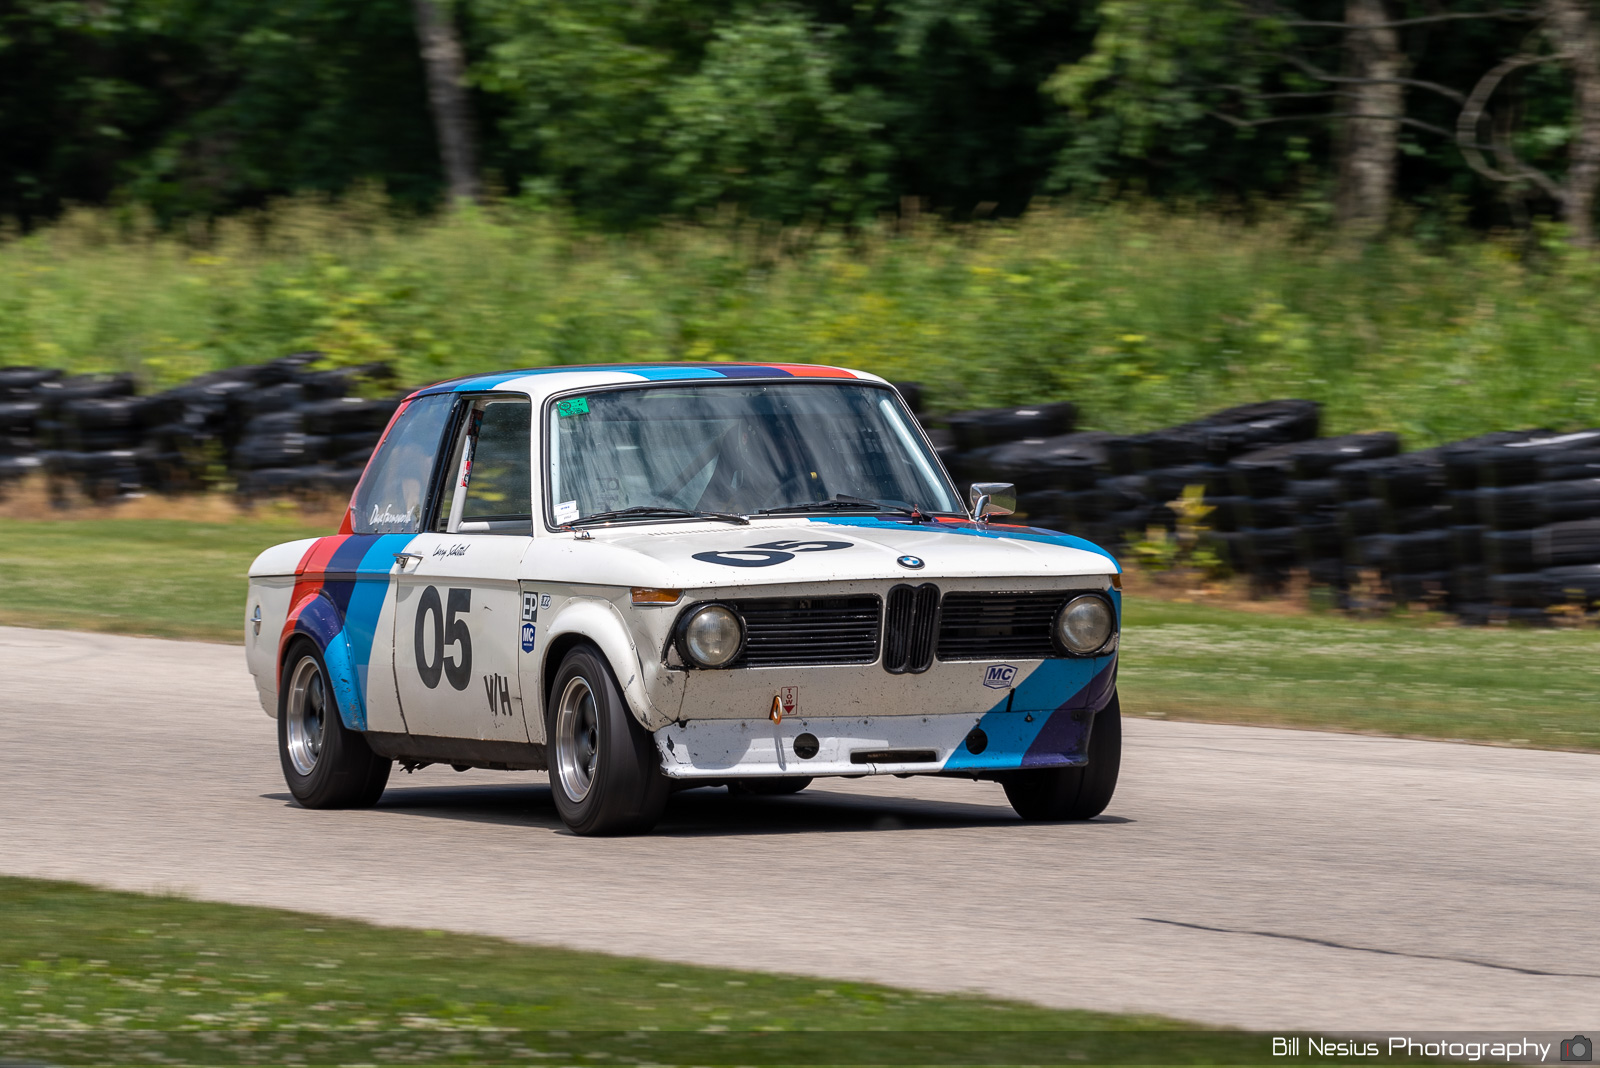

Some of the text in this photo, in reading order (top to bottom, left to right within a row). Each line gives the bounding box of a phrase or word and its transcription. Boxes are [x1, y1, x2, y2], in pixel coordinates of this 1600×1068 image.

[691, 540, 854, 567] 05
[522, 593, 537, 620] EP
[414, 585, 472, 691] 05
[523, 628, 534, 642] MC
[988, 668, 1013, 680] MC
[785, 688, 793, 705] TOW
